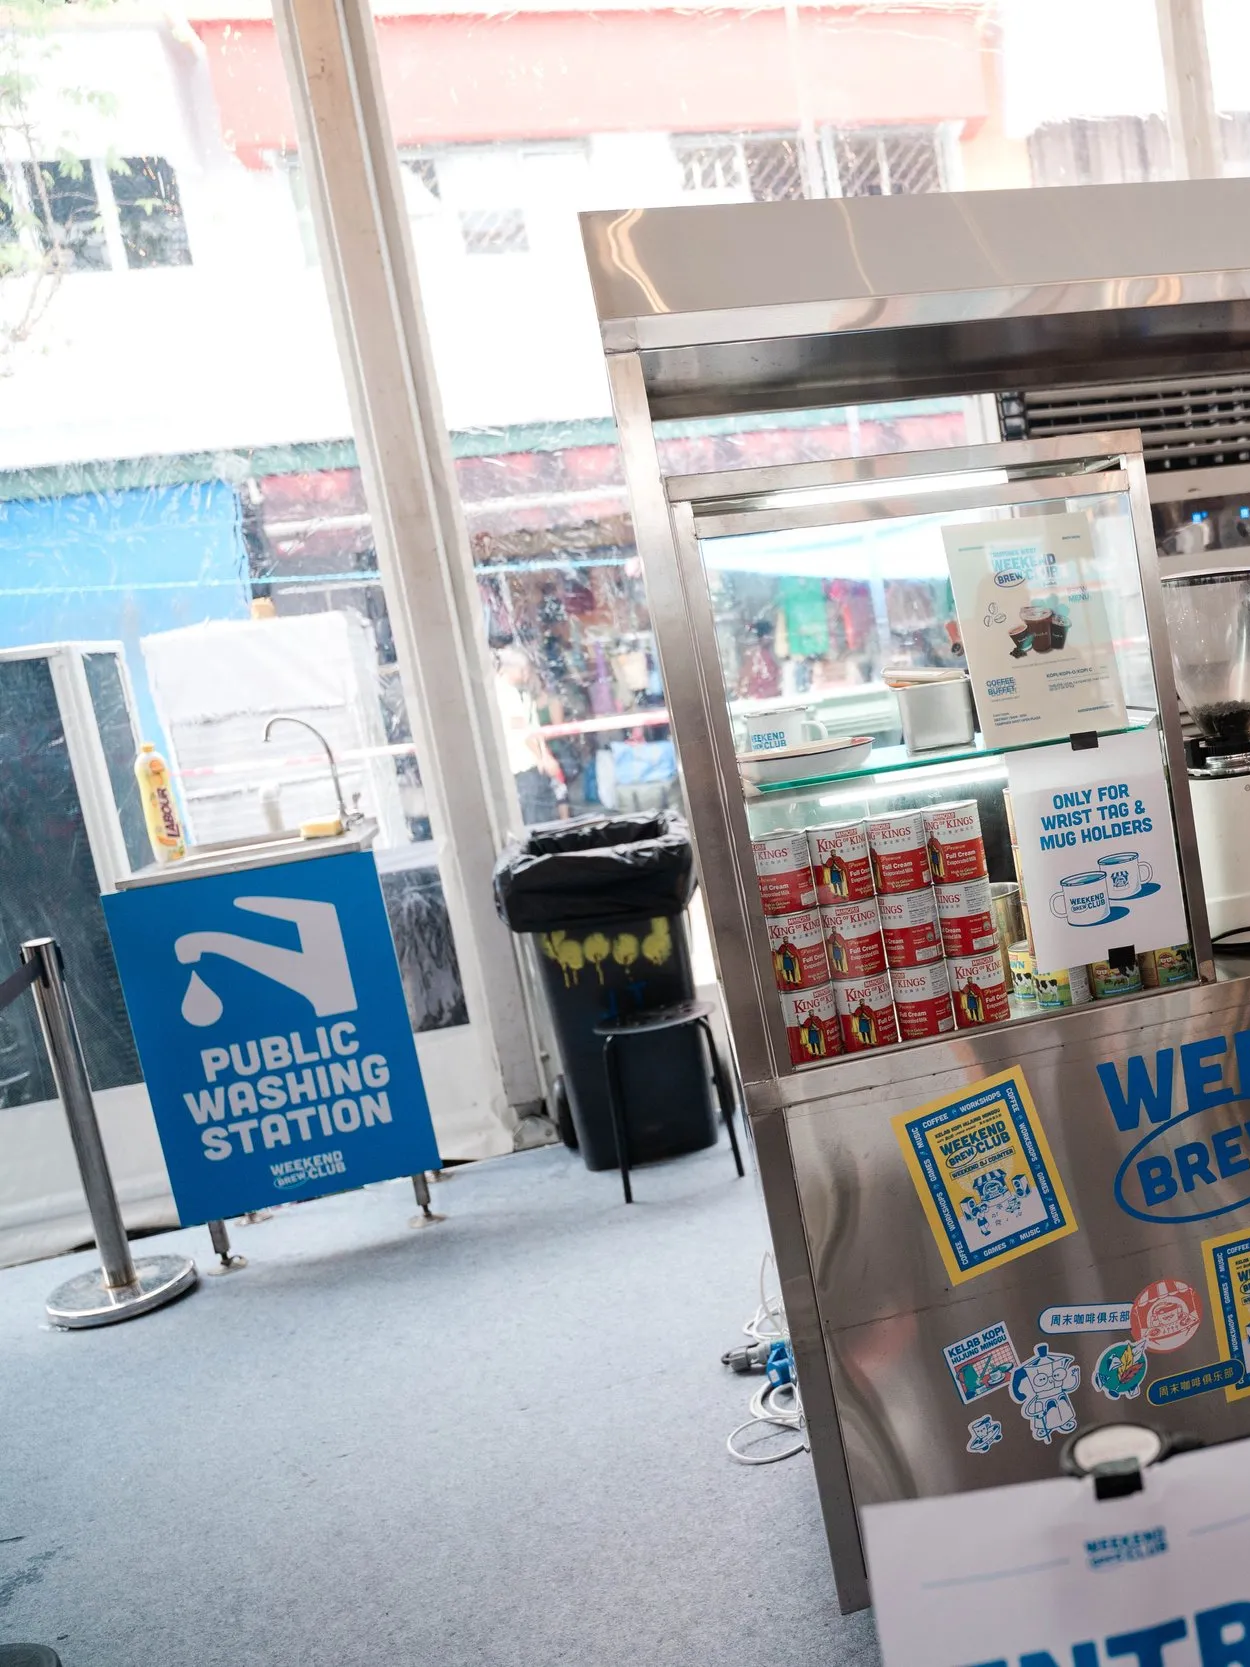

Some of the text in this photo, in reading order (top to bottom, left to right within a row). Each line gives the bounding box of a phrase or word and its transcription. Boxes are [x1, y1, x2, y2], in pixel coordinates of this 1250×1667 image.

[998, 572, 1022, 584] BREW
[986, 677, 1015, 687] COFFEE
[988, 686, 1016, 696] BUFFET
[752, 731, 785, 742] EEKEND
[765, 740, 787, 750] CLUB
[1053, 784, 1130, 810] ONLY FOR
[157, 787, 180, 838] LABOUR
[1040, 800, 1145, 831] WRIST TAG &
[946, 816, 974, 829] KINGS
[882, 827, 912, 839] KINGS
[1040, 817, 1153, 850] MUG HOLDERS
[816, 838, 843, 852] KING
[758, 848, 788, 860] KINGS
[938, 894, 961, 903] INGS
[1070, 892, 1104, 906] WEEKEND
[1072, 899, 1105, 912] BREW CLUB
[882, 905, 903, 914] INGS
[822, 910, 875, 928] KING KINGS
[769, 925, 795, 939] KING
[850, 946, 861, 954] Full
[954, 966, 978, 979] KING
[898, 976, 926, 988] KINGS
[845, 987, 871, 1002] KING
[986, 995, 995, 1003] Full
[793, 999, 820, 1014] KING
[200, 1021, 360, 1083] PUBLIC
[183, 1054, 390, 1125] WASHING
[922, 1112, 949, 1129] COFFEE
[960, 1091, 1001, 1113] WORKSHOPS
[201, 1091, 393, 1161] STATION
[940, 1120, 1006, 1156] WEEKEND
[949, 1131, 1010, 1166] BREW CLUB
[1006, 1087, 1061, 1225] COFFEE WORKSHOPS GAMES MUSIC
[270, 1150, 343, 1176] WEEKEND
[952, 1163, 979, 1178] WEEKEND
[988, 1148, 1014, 1162] COUNTER
[277, 1162, 346, 1186] BREW CLUB
[911, 1127, 969, 1265] COFFEE WORKSHOPS GAMES MUSIC
[983, 1226, 1041, 1257] GAMES MUSIC
[1226, 1243, 1250, 1254] COFFEE
[1217, 1253, 1238, 1352] WORKSHOPS GAMES MUSIC
[1050, 1311, 1130, 1326] 周末咖啡俱乐部
[948, 1326, 1004, 1358] KELAB KOPI
[951, 1335, 1007, 1365] HUJUNG MINGGU
[1158, 1367, 1234, 1397] 周末咖啡俱乐部
